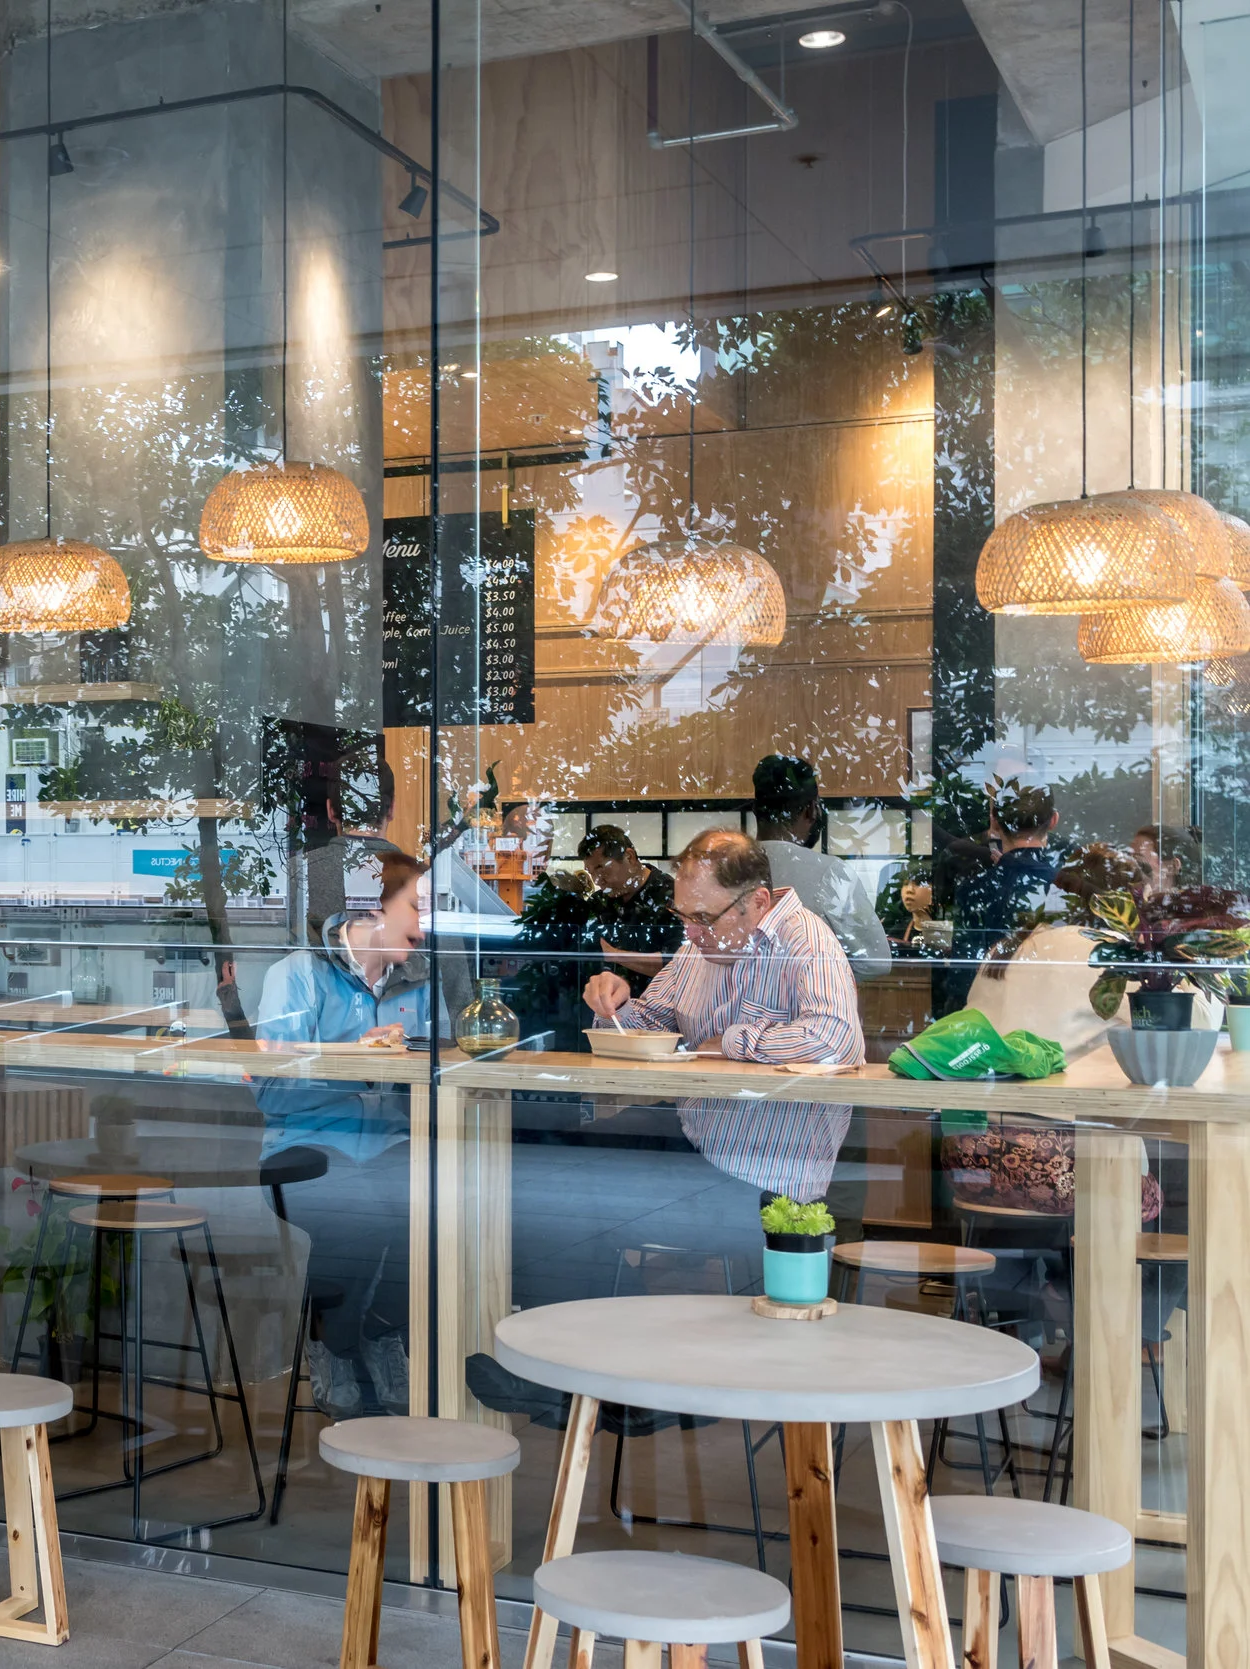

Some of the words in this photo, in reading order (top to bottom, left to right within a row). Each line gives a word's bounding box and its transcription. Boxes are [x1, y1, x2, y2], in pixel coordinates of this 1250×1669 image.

[485, 590, 516, 602] $3.50
[485, 606, 515, 618] $4.00
[440, 624, 471, 636] Juice
[485, 622, 515, 634] $5.00
[485, 638, 516, 650] $4.50
[485, 654, 514, 666] $3.00
[485, 670, 515, 682] $2.00
[485, 686, 514, 698] $3.00
